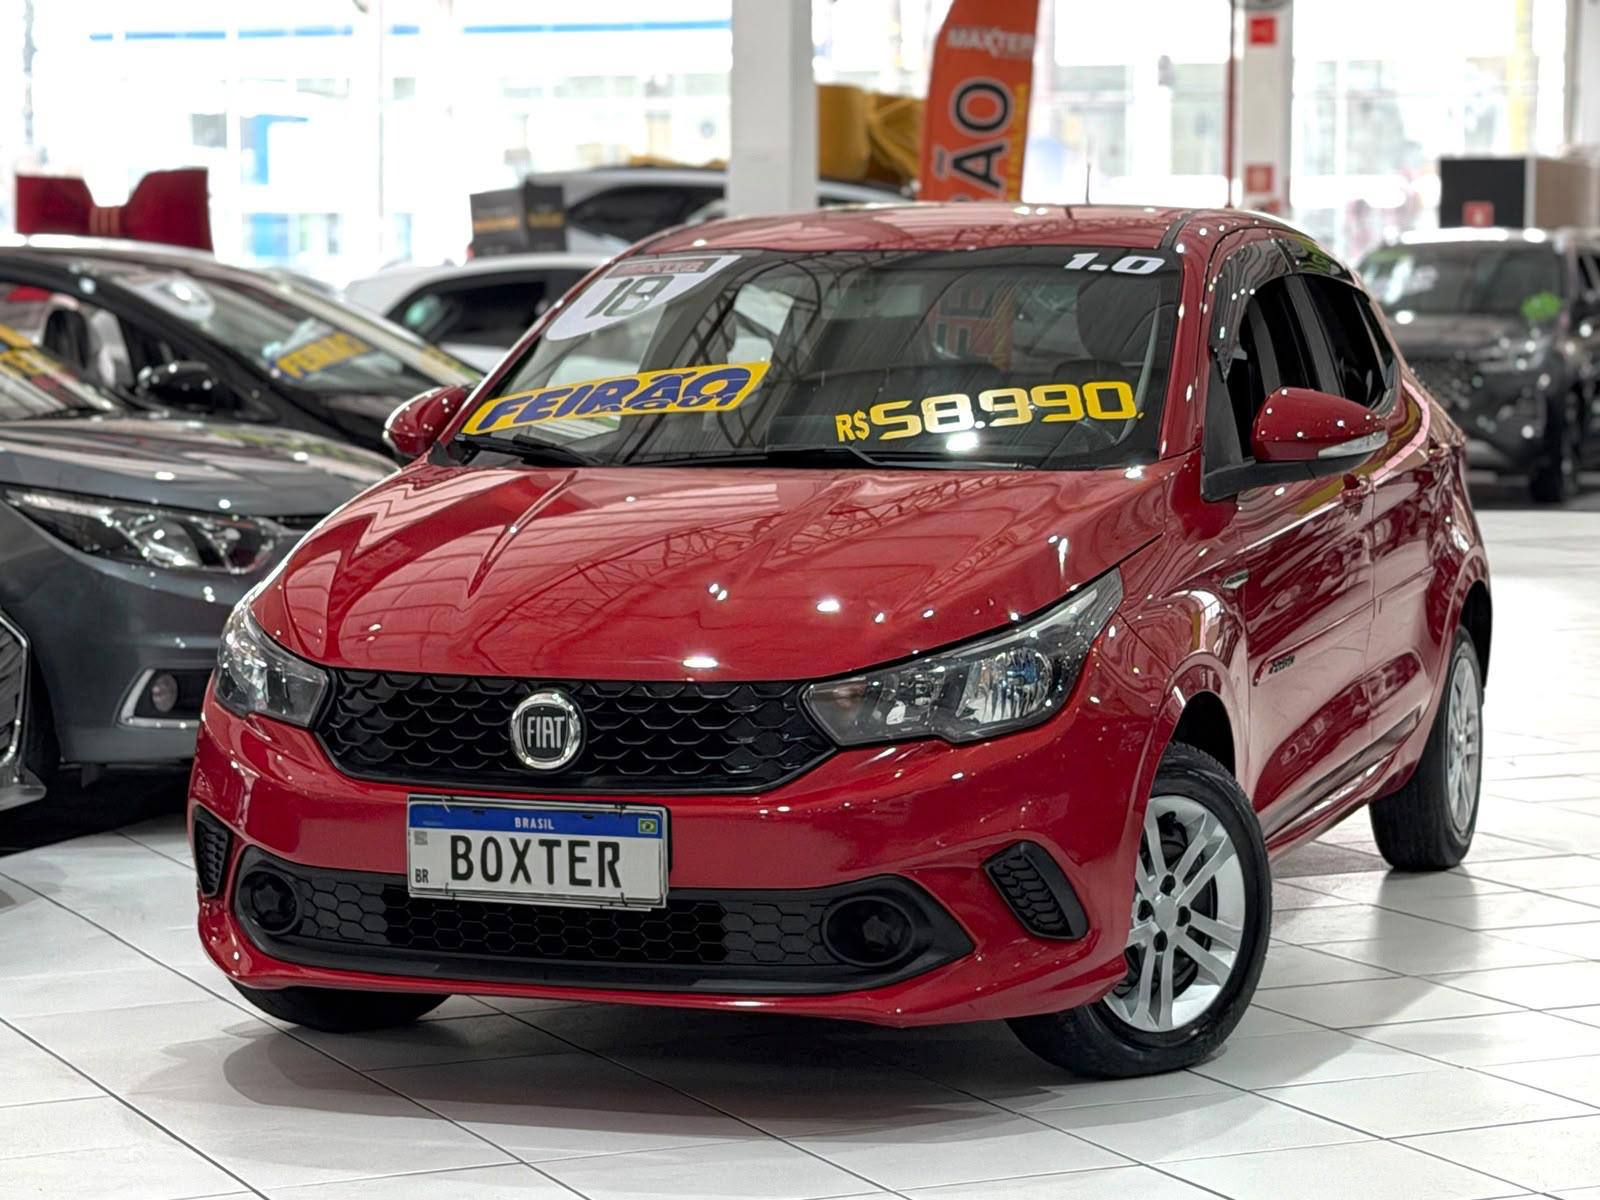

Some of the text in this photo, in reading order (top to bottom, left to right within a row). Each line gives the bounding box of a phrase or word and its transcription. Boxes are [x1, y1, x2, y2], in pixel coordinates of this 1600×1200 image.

[1064, 253, 1165, 275] 1.0
[585, 274, 676, 319] 18
[476, 367, 752, 431] FEIRÃO
[527, 716, 566, 749] FIAT
[513, 816, 555, 830] BRASIL
[415, 868, 429, 883] BR
[450, 834, 622, 888] BOXTER
